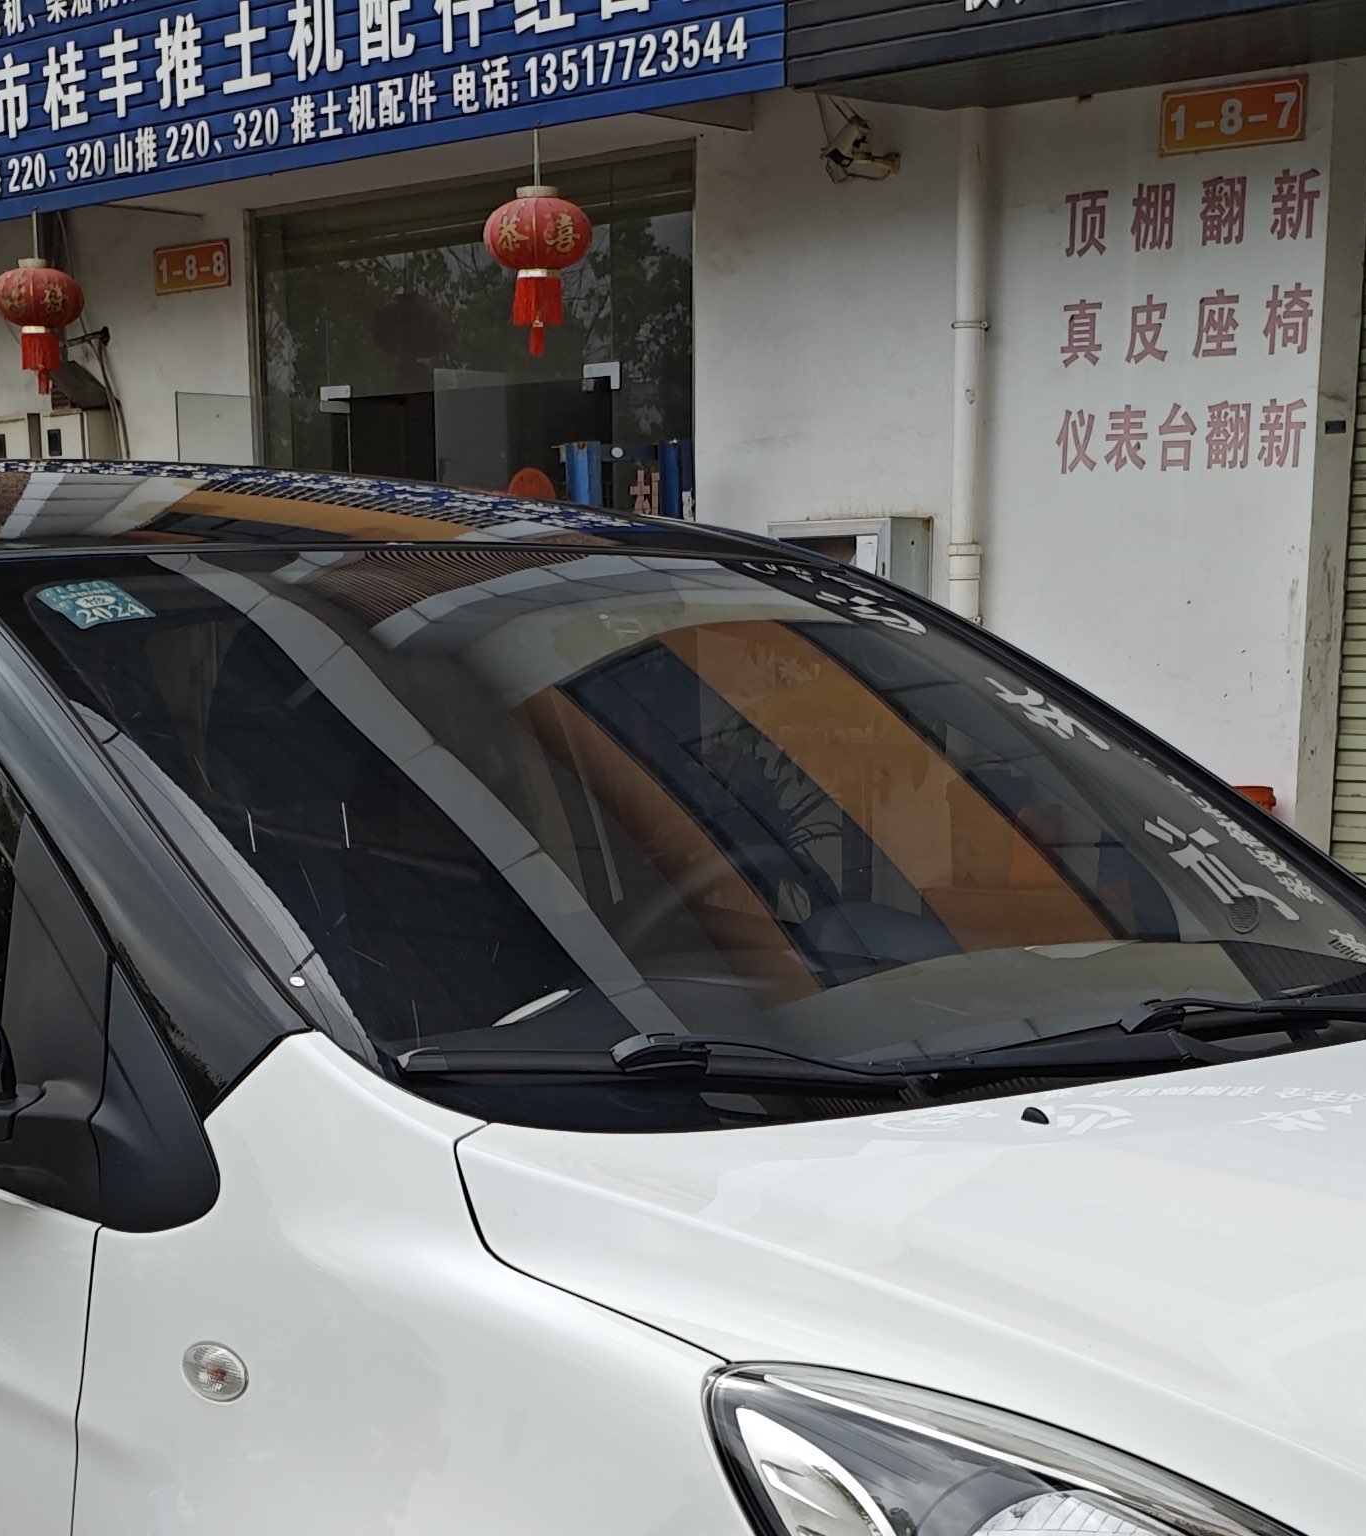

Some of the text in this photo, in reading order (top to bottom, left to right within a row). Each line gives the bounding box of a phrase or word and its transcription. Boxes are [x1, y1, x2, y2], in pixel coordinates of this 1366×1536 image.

[1169, 91, 1298, 142] 1-8-7
[1064, 168, 1321, 258] 顶棚翻新
[158, 250, 225, 285] 1-8-8
[1060, 282, 1314, 368] 真皮座椅
[1055, 398, 1308, 475] 仪表台翻新
[76, 603, 146, 625] 2024
